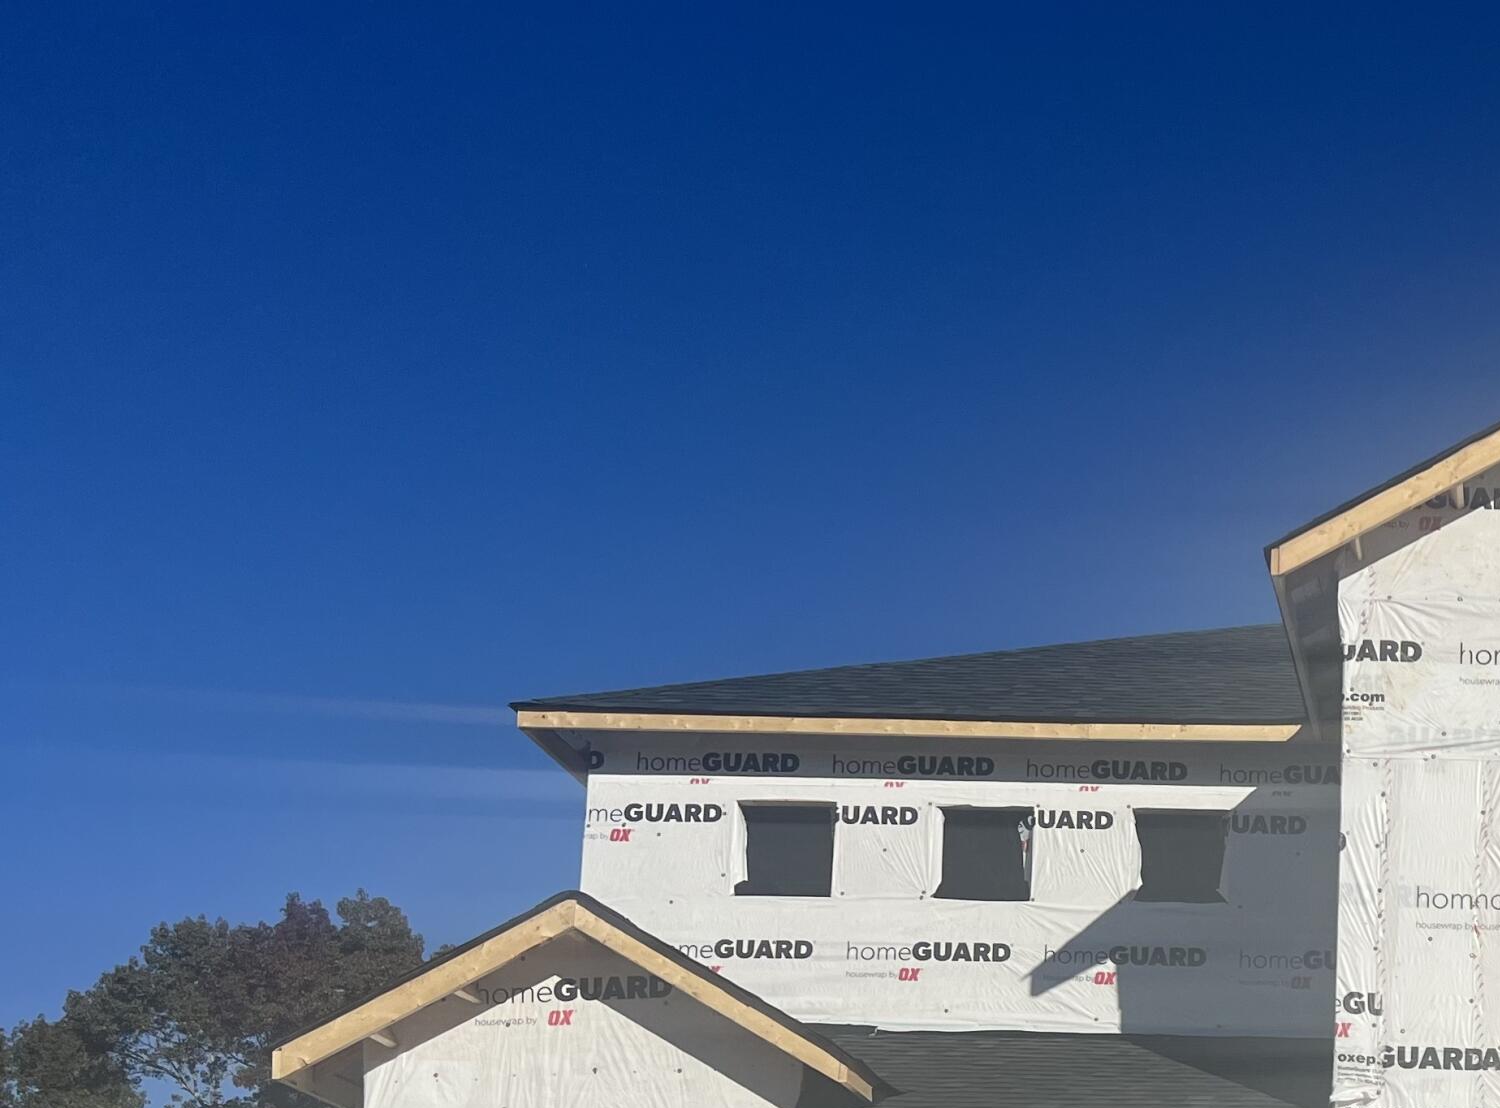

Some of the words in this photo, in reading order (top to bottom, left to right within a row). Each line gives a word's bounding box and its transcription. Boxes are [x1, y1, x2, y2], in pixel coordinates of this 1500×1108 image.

[637, 752, 799, 773] homeGUARD
[832, 755, 994, 776] homeGUARD
[1027, 759, 1188, 781] homeGUARD
[609, 828, 632, 842] OX
[846, 941, 1011, 963] homeGUARD
[1044, 945, 1207, 967] homeGUARD
[899, 968, 920, 981] OX
[1095, 972, 1116, 985] OX
[1291, 976, 1310, 990] OX
[548, 1010, 573, 1026] OX
